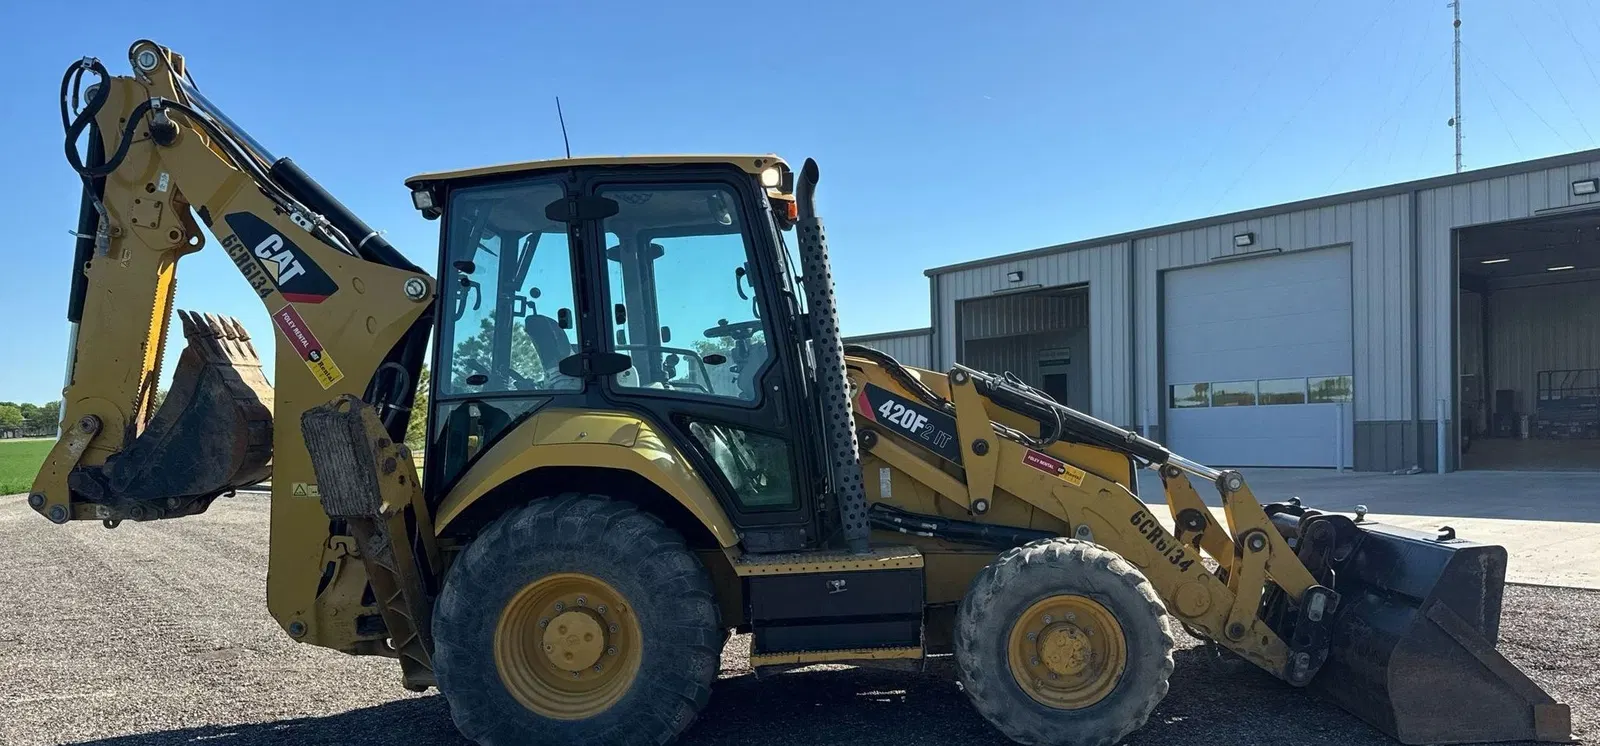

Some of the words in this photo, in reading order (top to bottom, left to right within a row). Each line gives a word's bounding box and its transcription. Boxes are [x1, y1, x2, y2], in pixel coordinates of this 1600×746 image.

[221, 233, 275, 300] 6CR6134
[254, 233, 306, 287] CAT
[282, 312, 297, 329] FOLEY
[292, 327, 310, 349] RENTAL
[309, 350, 320, 361] CAT
[317, 361, 336, 383] Rental
[933, 430, 953, 449] IT
[1027, 455, 1040, 463] FOLEY
[1039, 460, 1055, 470] RENTAL
[1129, 510, 1195, 573] 6CR6134
